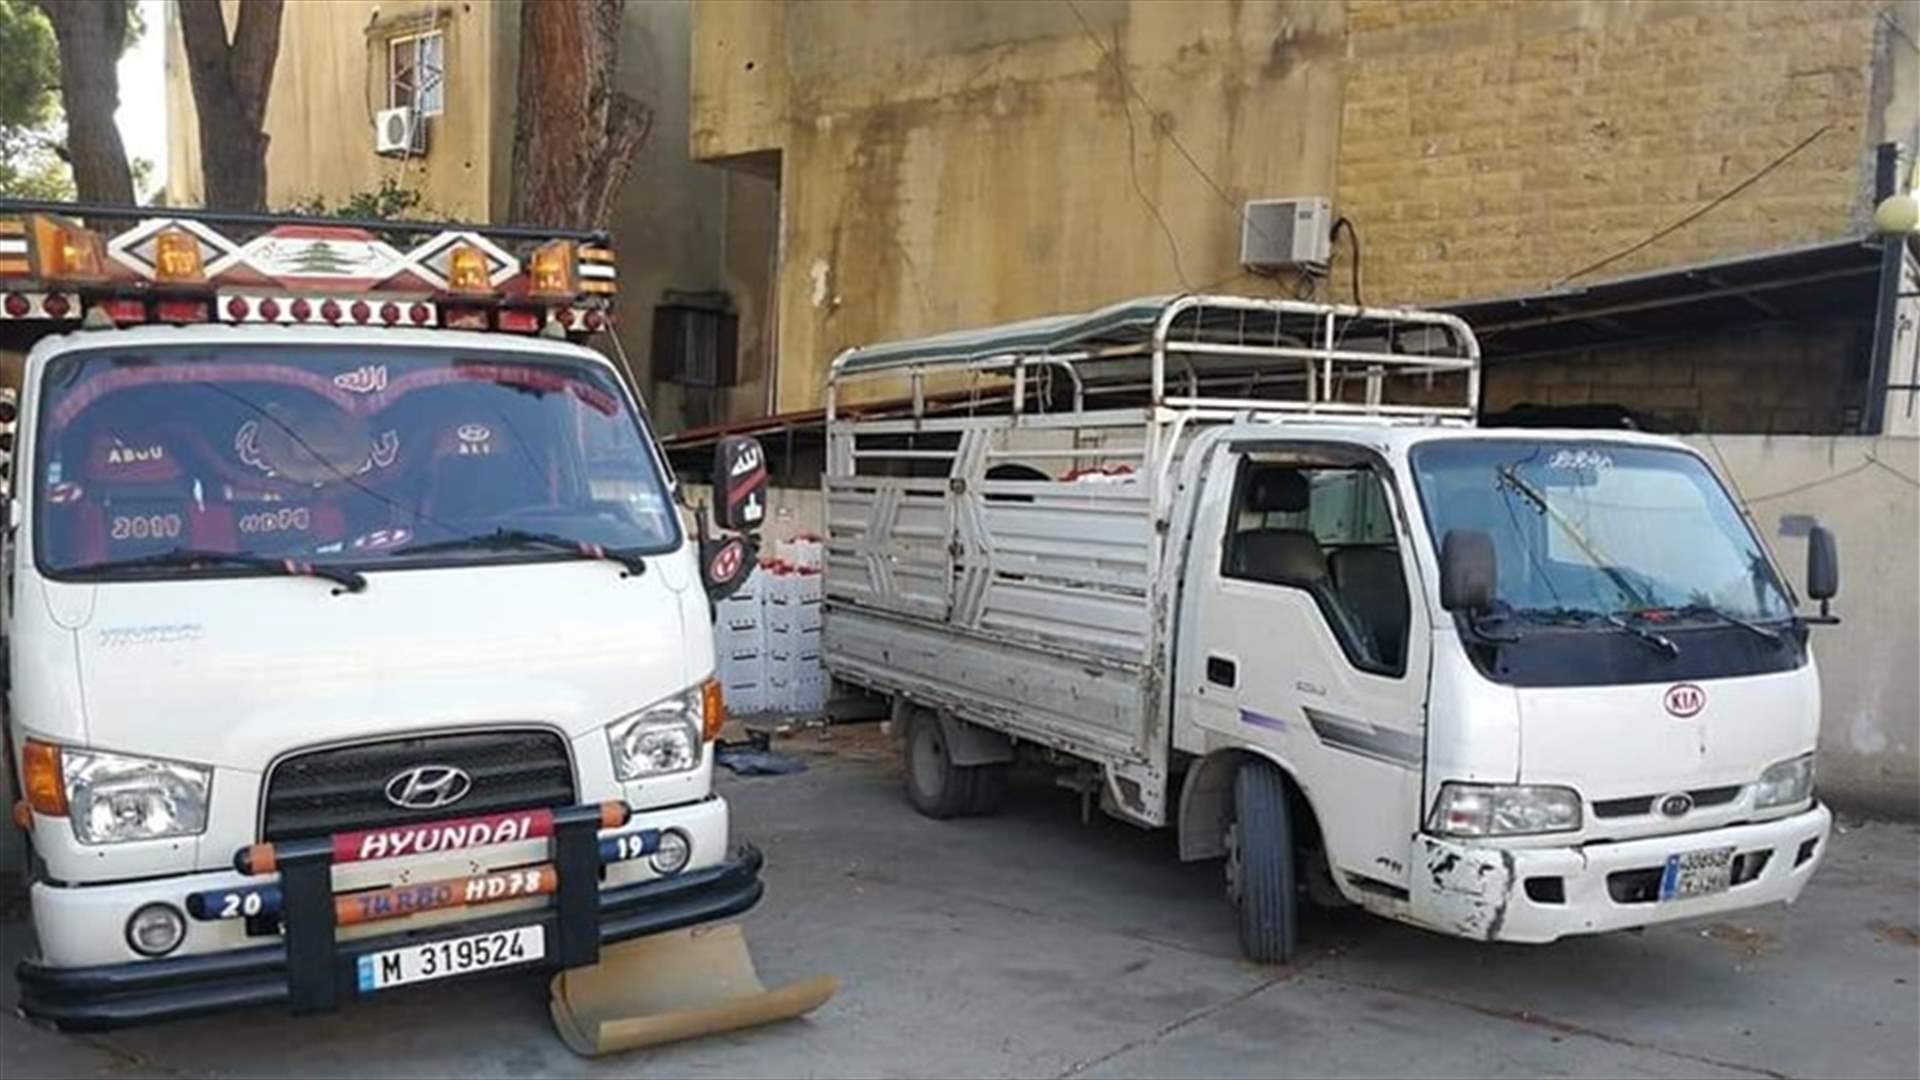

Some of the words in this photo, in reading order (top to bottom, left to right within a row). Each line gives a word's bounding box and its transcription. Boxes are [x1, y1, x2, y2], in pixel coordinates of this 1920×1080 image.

[1671, 691, 1700, 711] KIA
[359, 816, 531, 859] HYUNDAI
[616, 834, 643, 858] 19
[464, 871, 541, 901] HD78
[223, 890, 262, 916] 20
[382, 952, 402, 984] M
[421, 930, 525, 977] 319524
